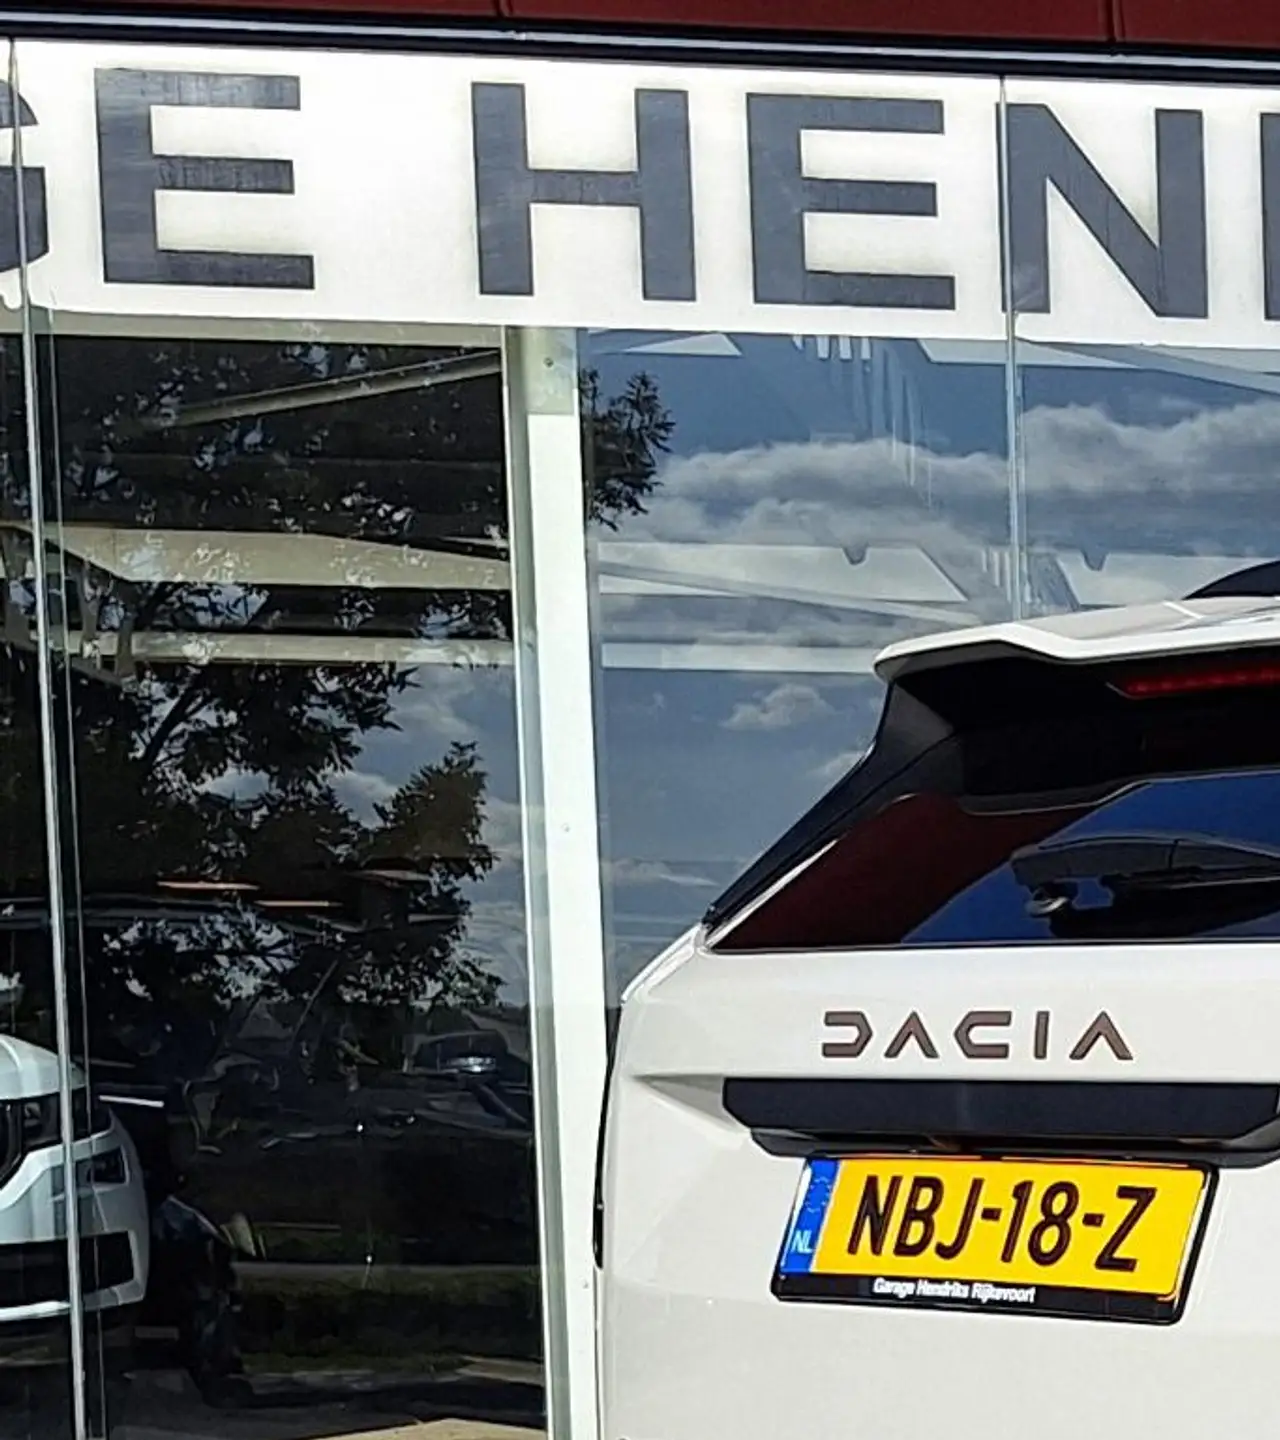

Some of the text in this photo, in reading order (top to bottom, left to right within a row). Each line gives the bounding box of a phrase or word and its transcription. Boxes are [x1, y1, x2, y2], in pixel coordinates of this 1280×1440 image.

[0, 68, 316, 291] E
[821, 1010, 1134, 1060] DACIA
[790, 1174, 1158, 1273] NL NBJ-18-Z
